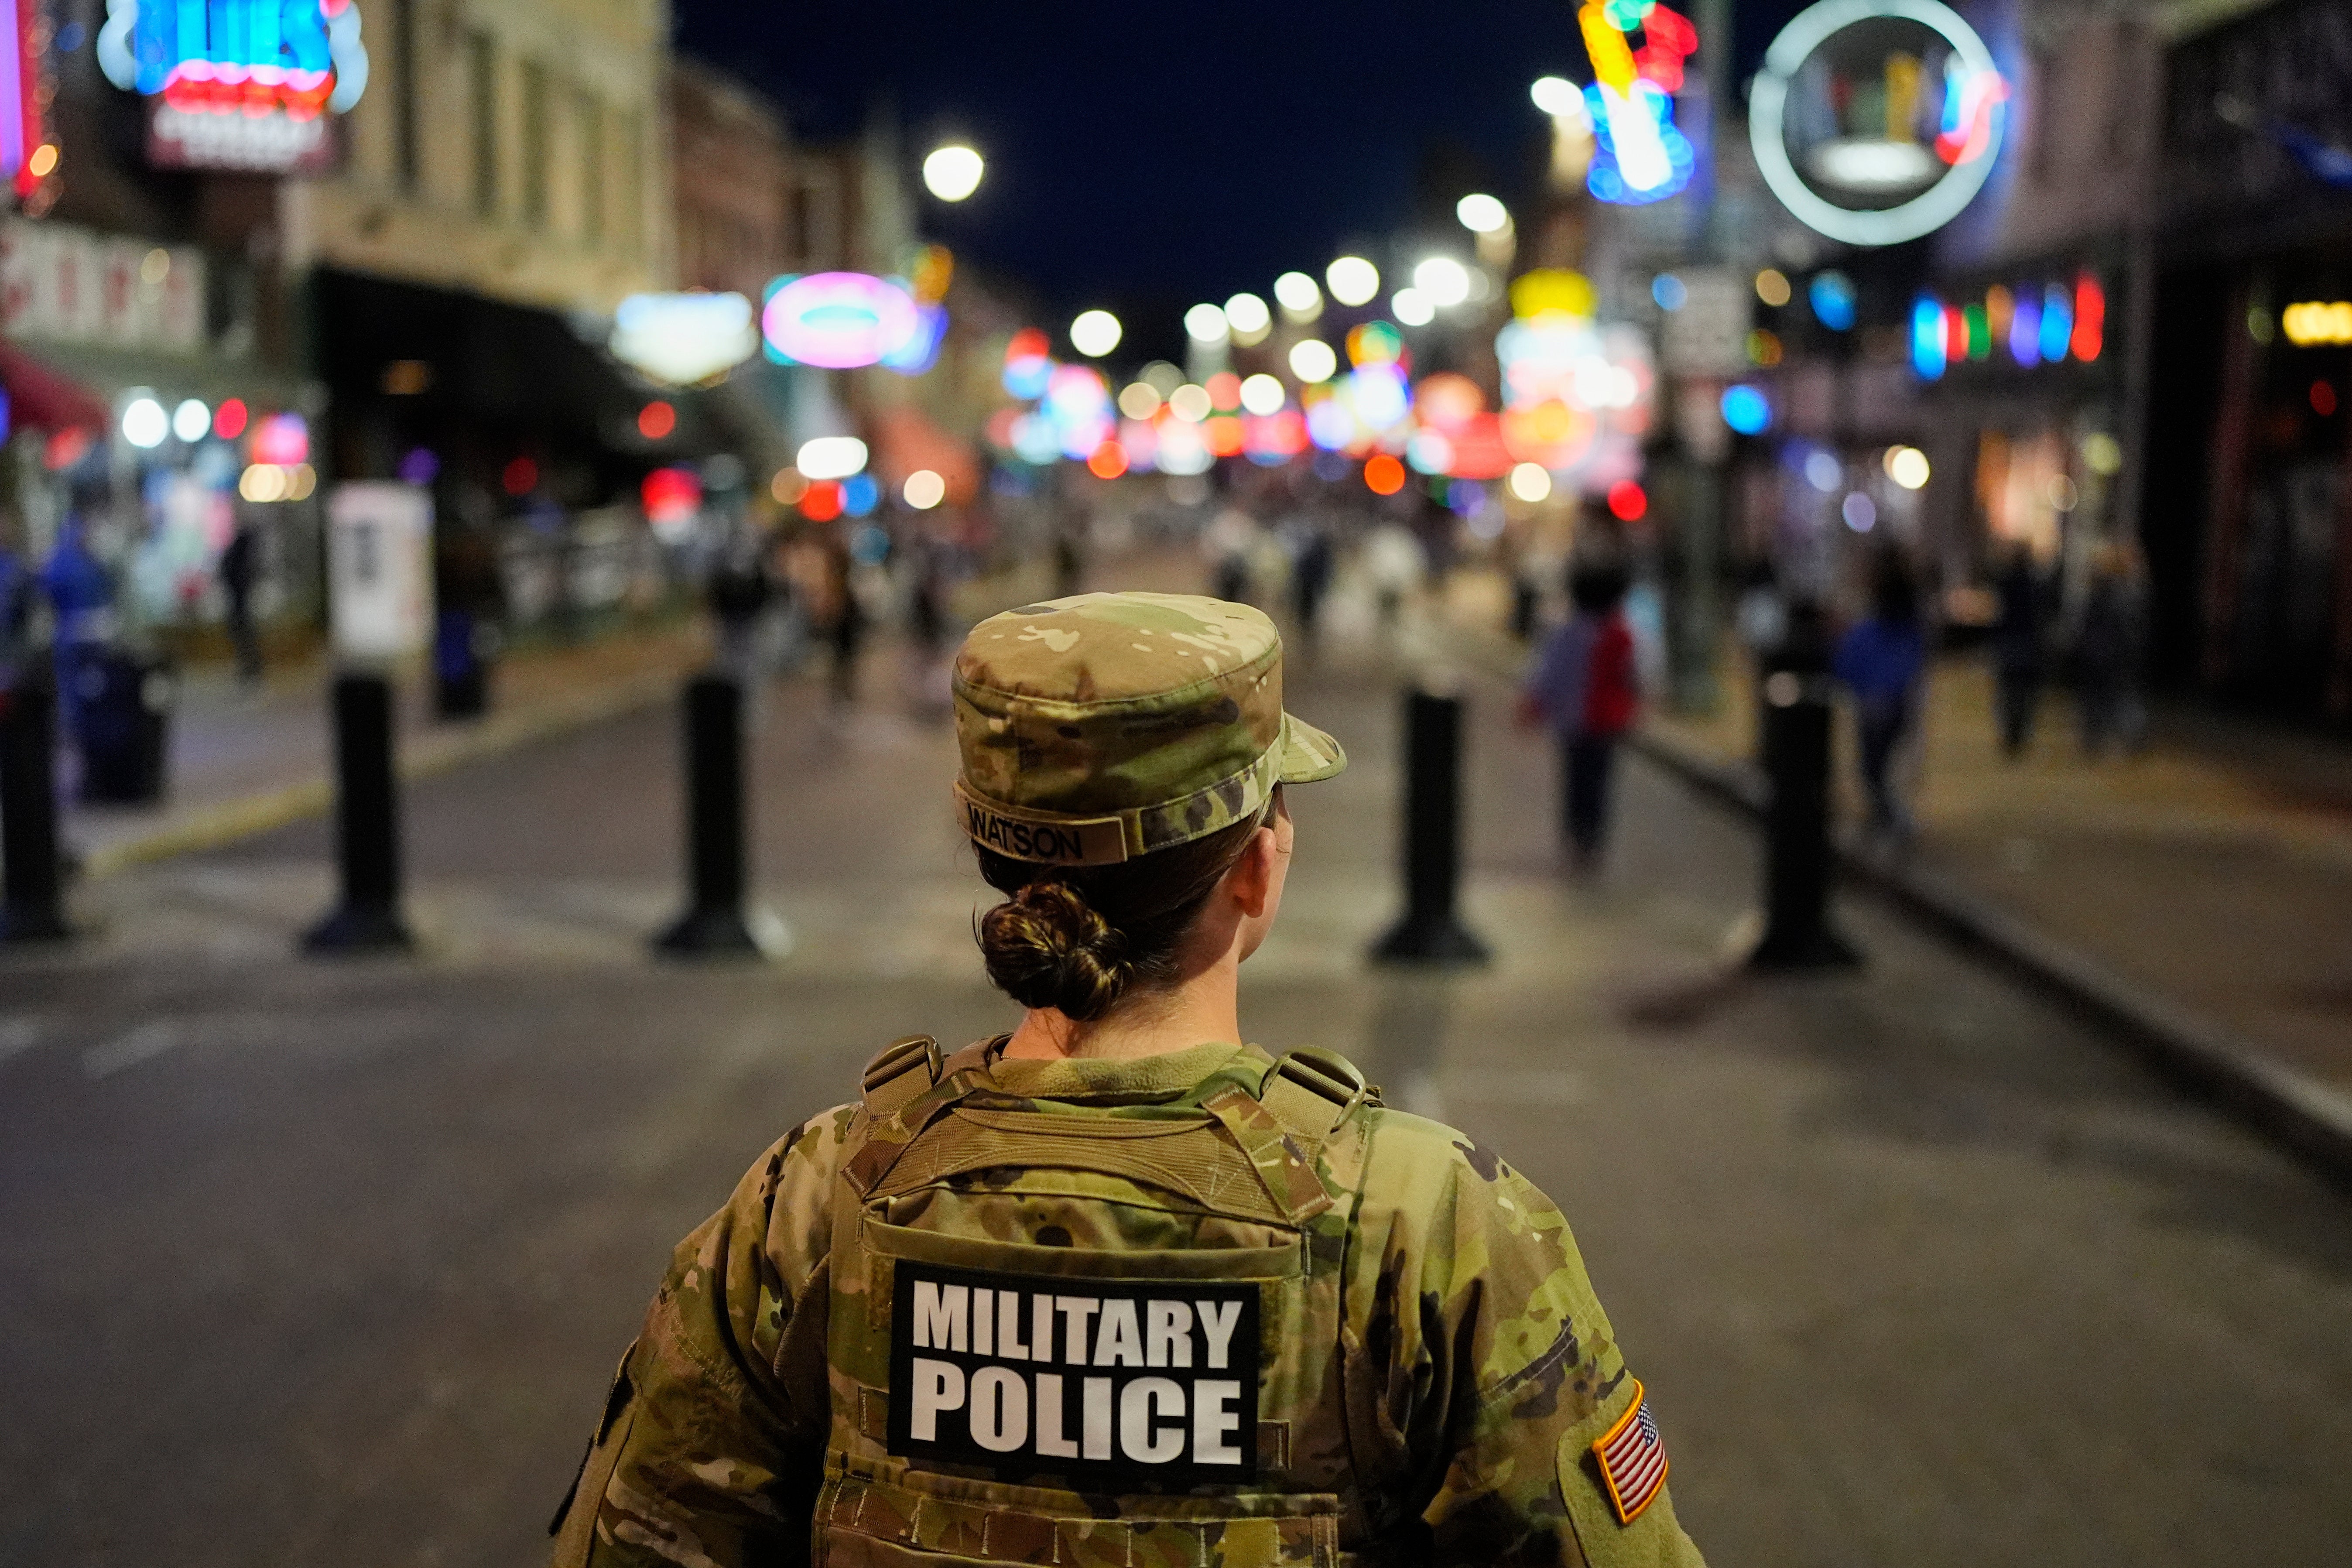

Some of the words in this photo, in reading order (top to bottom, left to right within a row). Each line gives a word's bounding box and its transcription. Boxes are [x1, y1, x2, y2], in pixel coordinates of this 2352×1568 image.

[967, 803, 1083, 859] WATSON
[913, 1280, 1243, 1369] MILITARY
[911, 1357, 1242, 1465] POLICE
